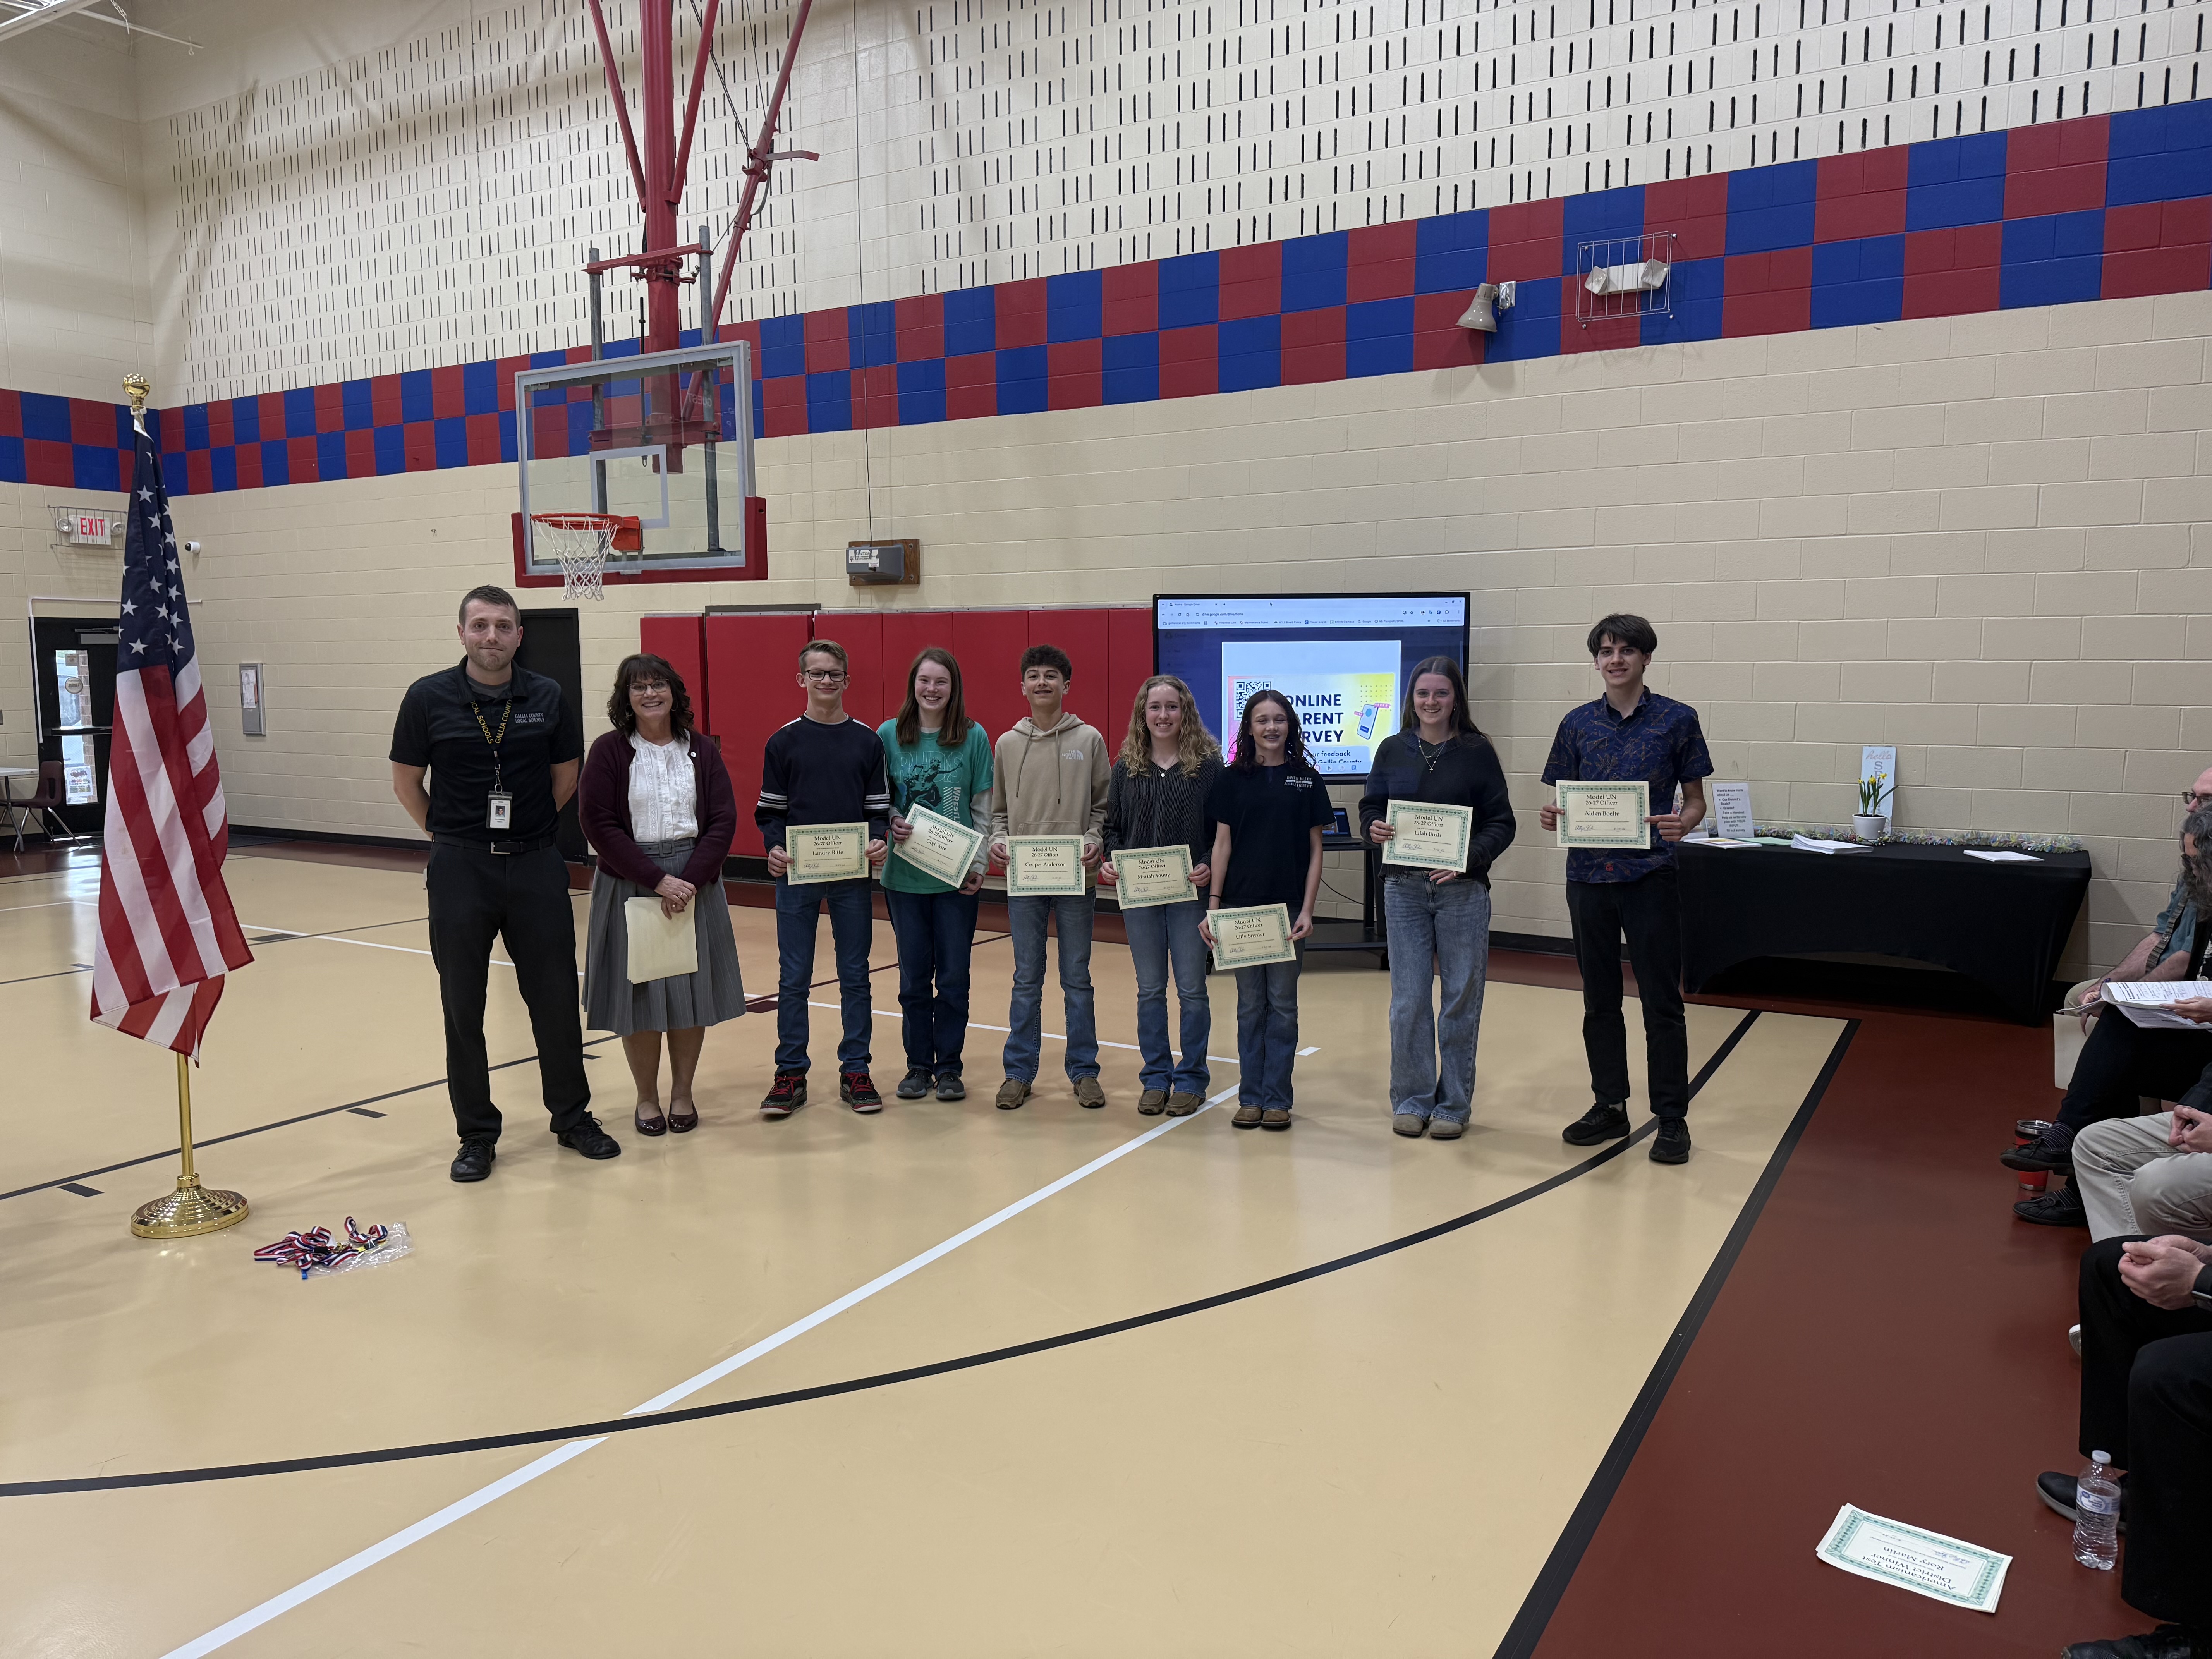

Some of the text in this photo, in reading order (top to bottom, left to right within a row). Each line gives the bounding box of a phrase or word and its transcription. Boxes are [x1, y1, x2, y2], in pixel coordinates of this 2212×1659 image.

[80, 517, 105, 536] EXIT
[1303, 712, 1344, 725] RENT
[477, 715, 494, 744] SCHOOLS
[495, 723, 506, 744] GALLIA
[1302, 730, 1344, 742] RVEY
[1865, 750, 1892, 760] hello
[931, 824, 946, 834] Model
[939, 834, 953, 843] Officer
[1862, 1555, 1882, 1565] Test
[1871, 1553, 1910, 1570] Winner
[1884, 1546, 1917, 1563] Martin
[1920, 1559, 1944, 1571] Rory
[1886, 1563, 1956, 1590] Americanism
[1913, 1565, 1951, 1584] District
